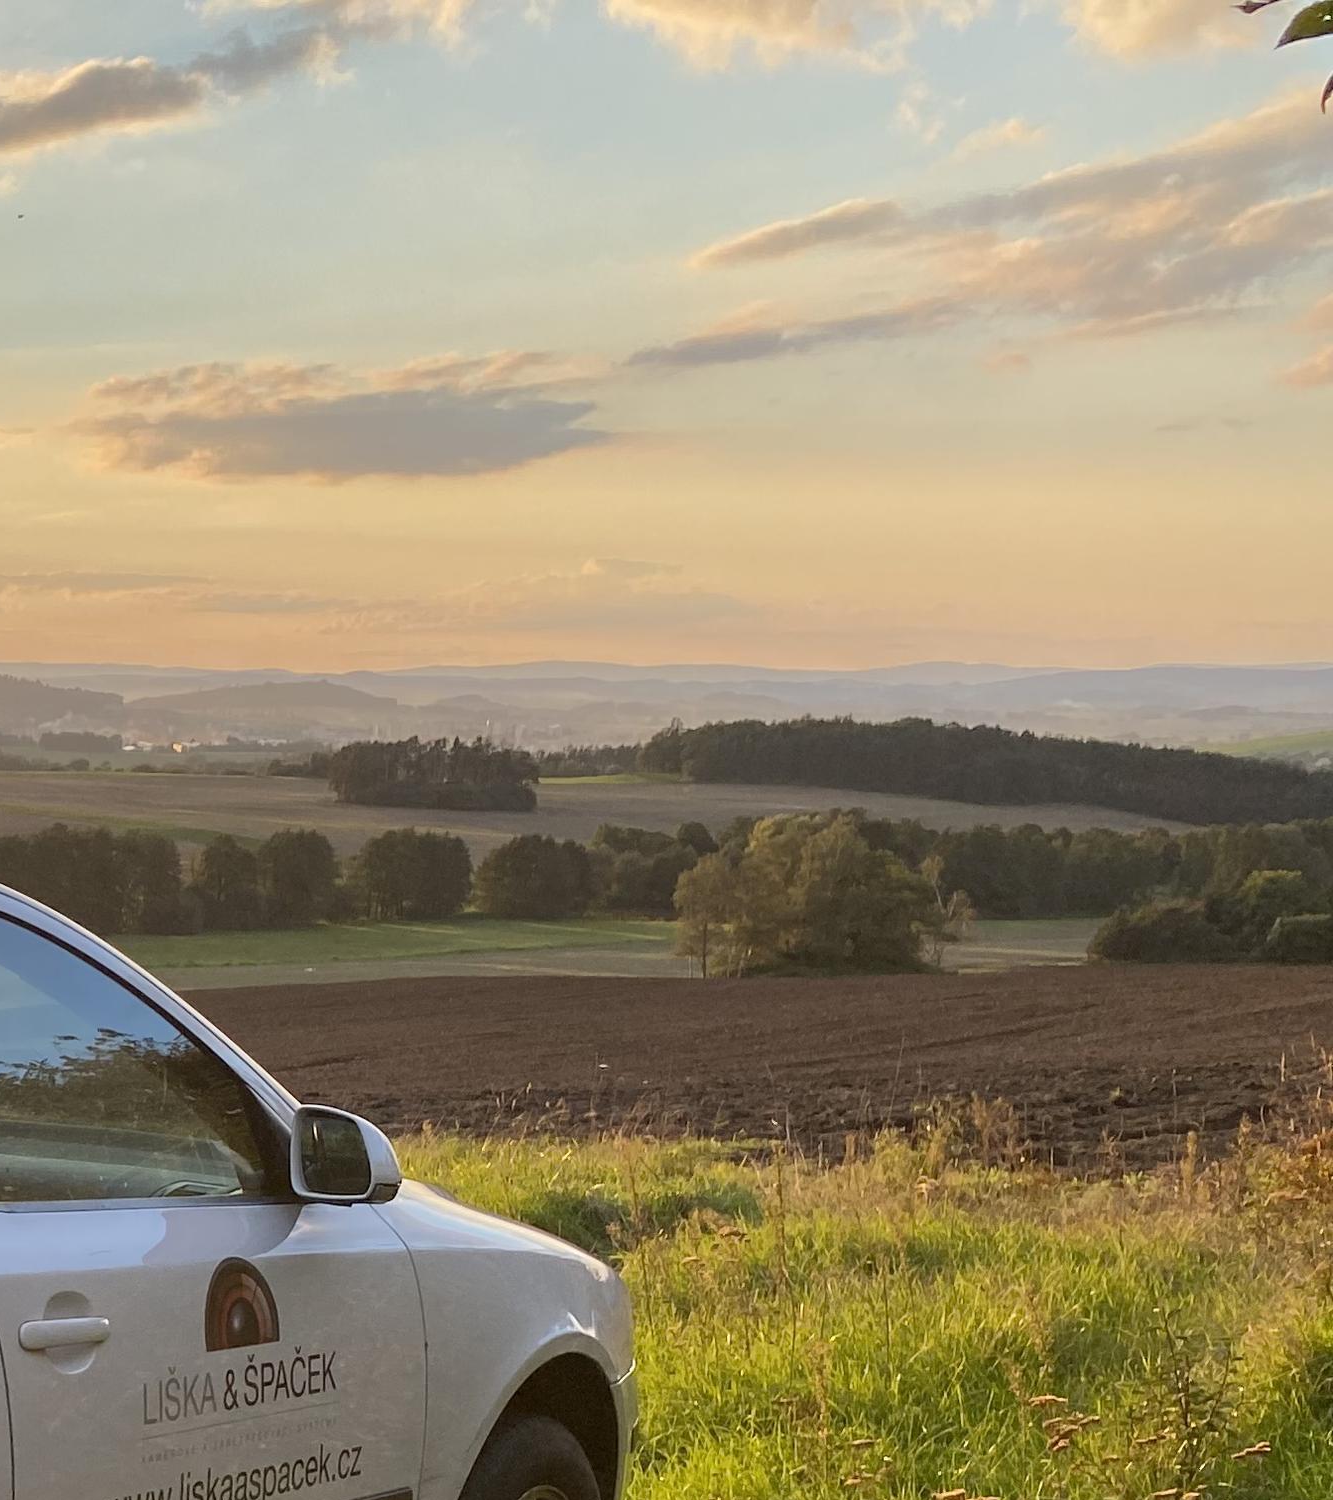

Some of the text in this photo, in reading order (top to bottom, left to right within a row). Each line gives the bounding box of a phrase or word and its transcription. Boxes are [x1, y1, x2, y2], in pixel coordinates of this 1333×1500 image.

[142, 1346, 337, 1425] LIŠKA & ŠPAČEK
